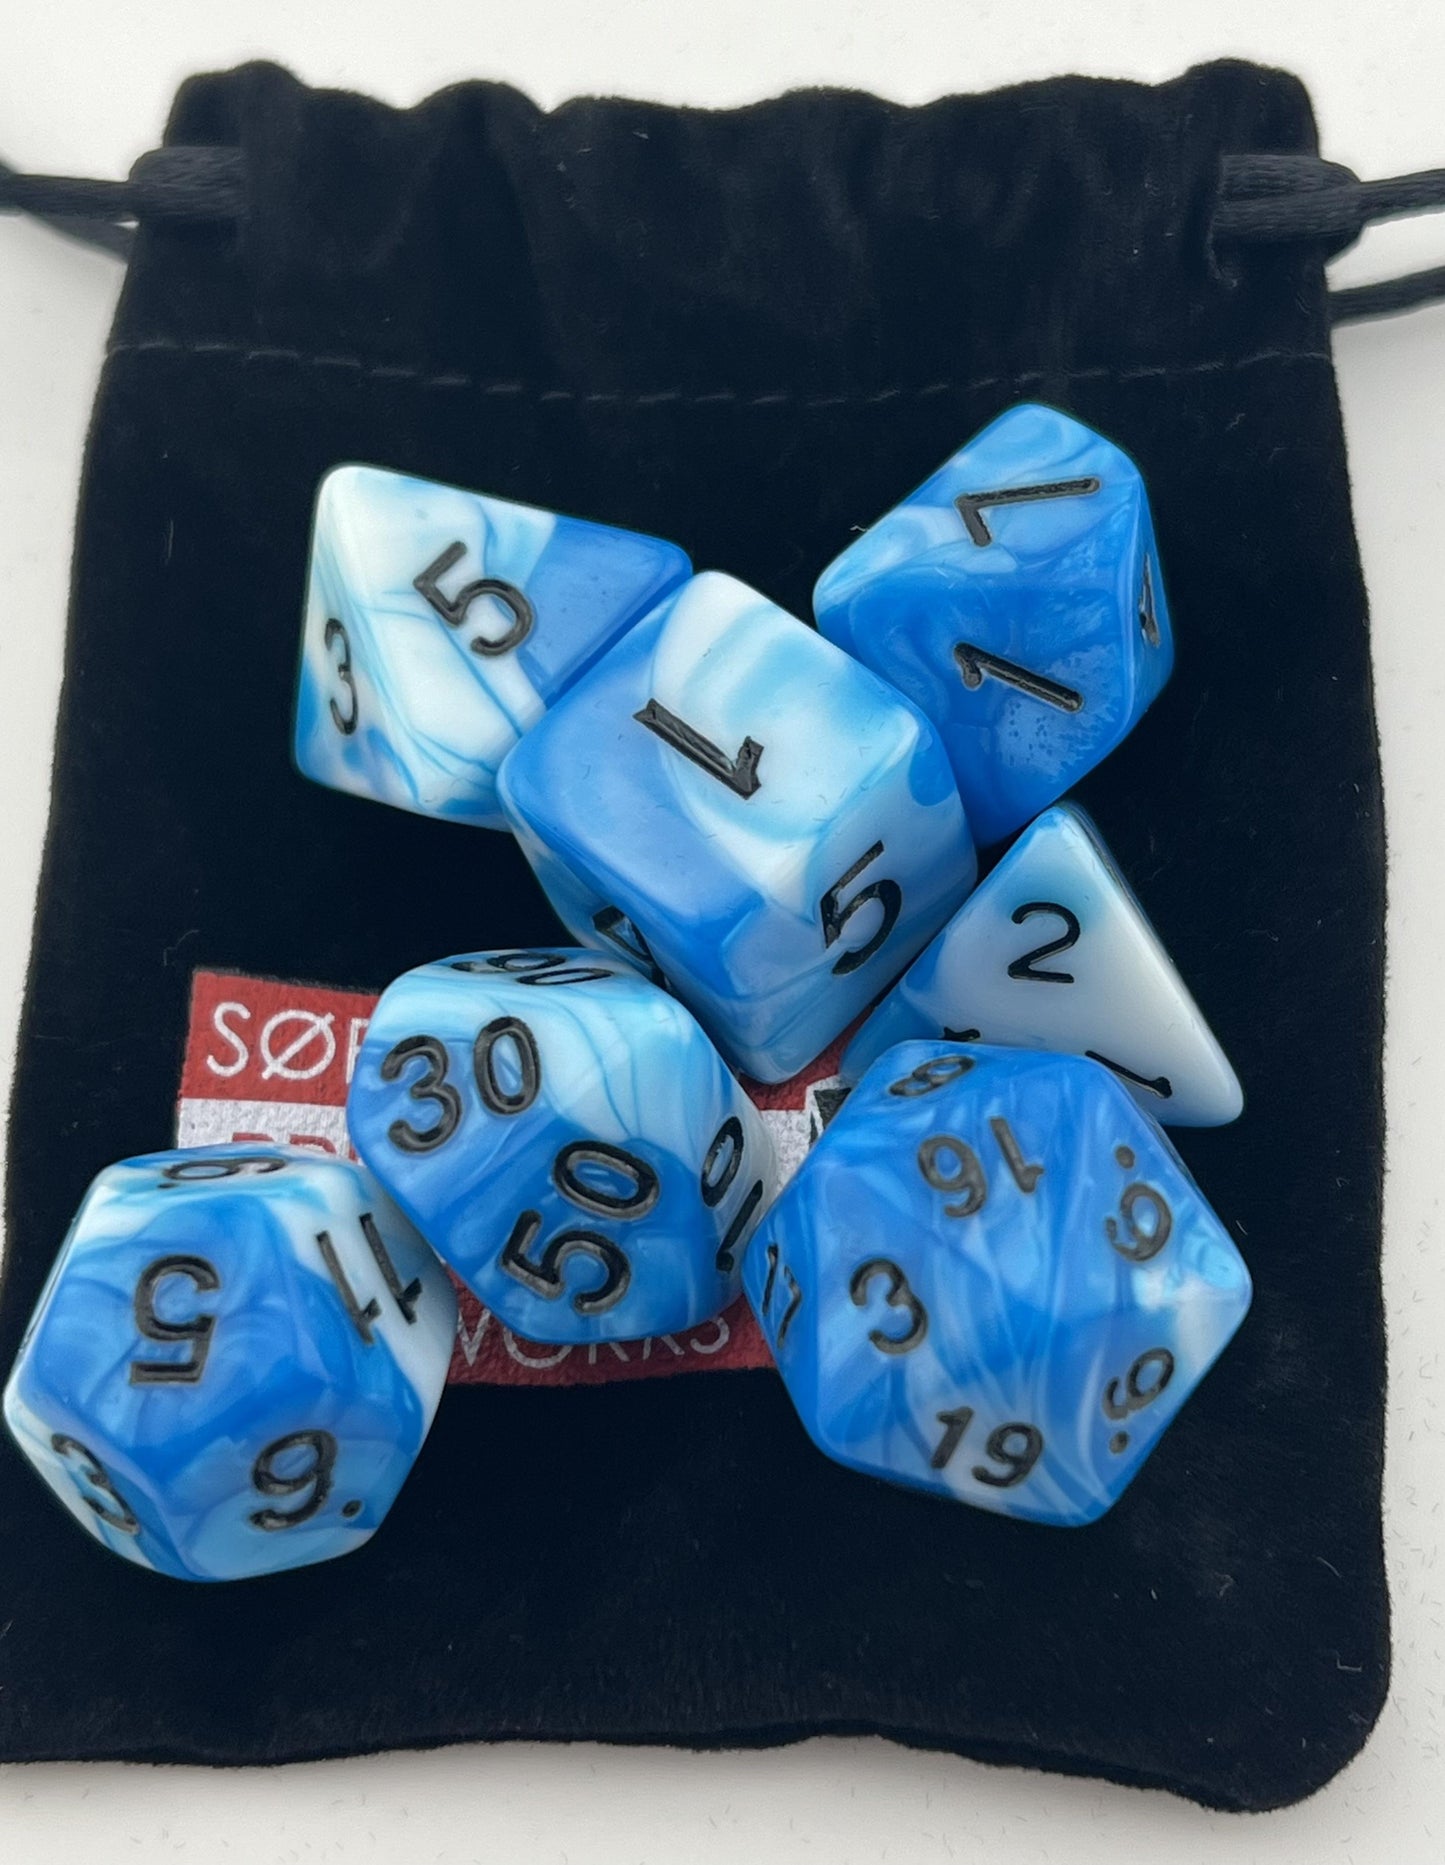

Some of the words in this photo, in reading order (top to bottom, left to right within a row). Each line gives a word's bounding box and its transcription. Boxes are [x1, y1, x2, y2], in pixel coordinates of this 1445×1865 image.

[954, 475, 1101, 548] 7
[413, 540, 535, 657] 5
[325, 618, 359, 736] 3
[954, 641, 1084, 712] 1
[633, 698, 765, 801] 1
[820, 839, 902, 976] 5
[1006, 901, 1081, 984] 2
[380, 1016, 541, 1156] 30
[888, 1055, 977, 1098] 8
[500, 1139, 660, 1316] 50
[701, 1116, 763, 1273] 10
[128, 1253, 221, 1388] 5
[315, 1211, 424, 1346] 11
[848, 1257, 929, 1355] 3
[50, 1432, 140, 1536] 3
[930, 1405, 1045, 1488] 19
